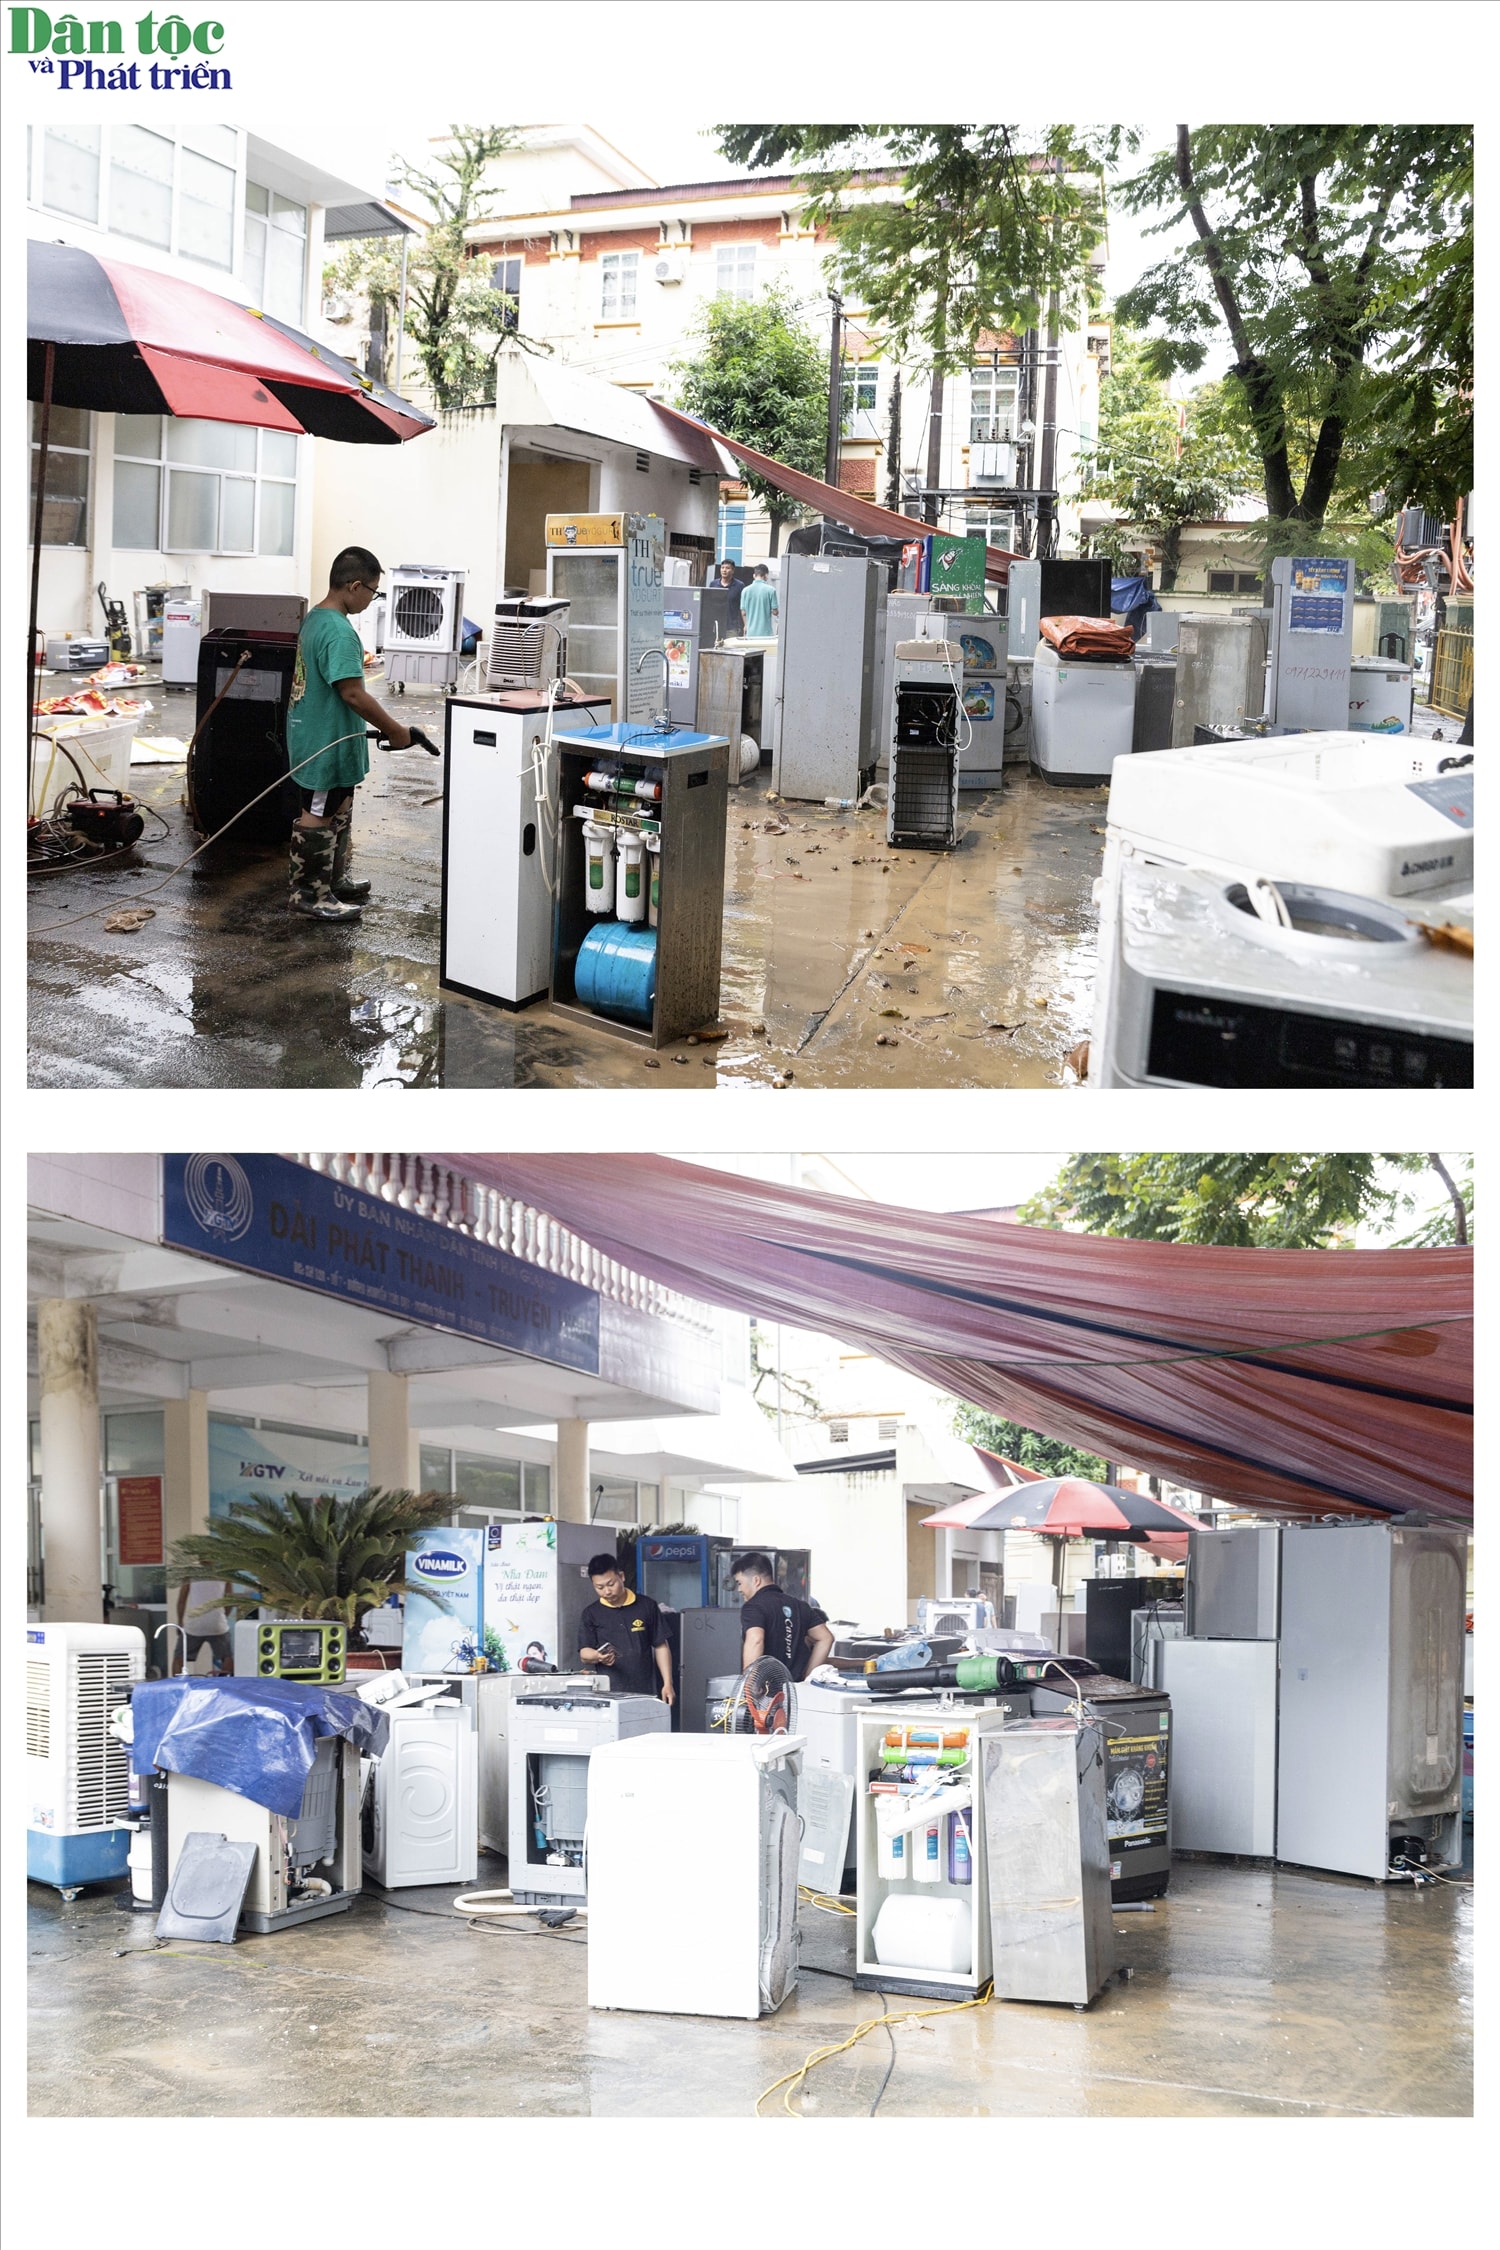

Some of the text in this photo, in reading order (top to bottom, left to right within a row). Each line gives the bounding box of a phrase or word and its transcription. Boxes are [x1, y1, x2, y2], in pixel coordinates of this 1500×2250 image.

[632, 539, 650, 558] TH
[632, 560, 662, 588] true
[611, 814, 639, 827] ROSTAR
[334, 1185, 354, 1212] ỦY
[358, 1201, 391, 1228] BAN
[270, 1199, 316, 1250] ĐÀI
[328, 1222, 390, 1274] PHÁT
[397, 1247, 465, 1301] THANH
[665, 1546, 696, 1558] pepsi
[418, 1558, 465, 1572] VINAMILK
[784, 1618, 793, 1659] Casper
[1124, 1838, 1151, 1847] Panasonic
